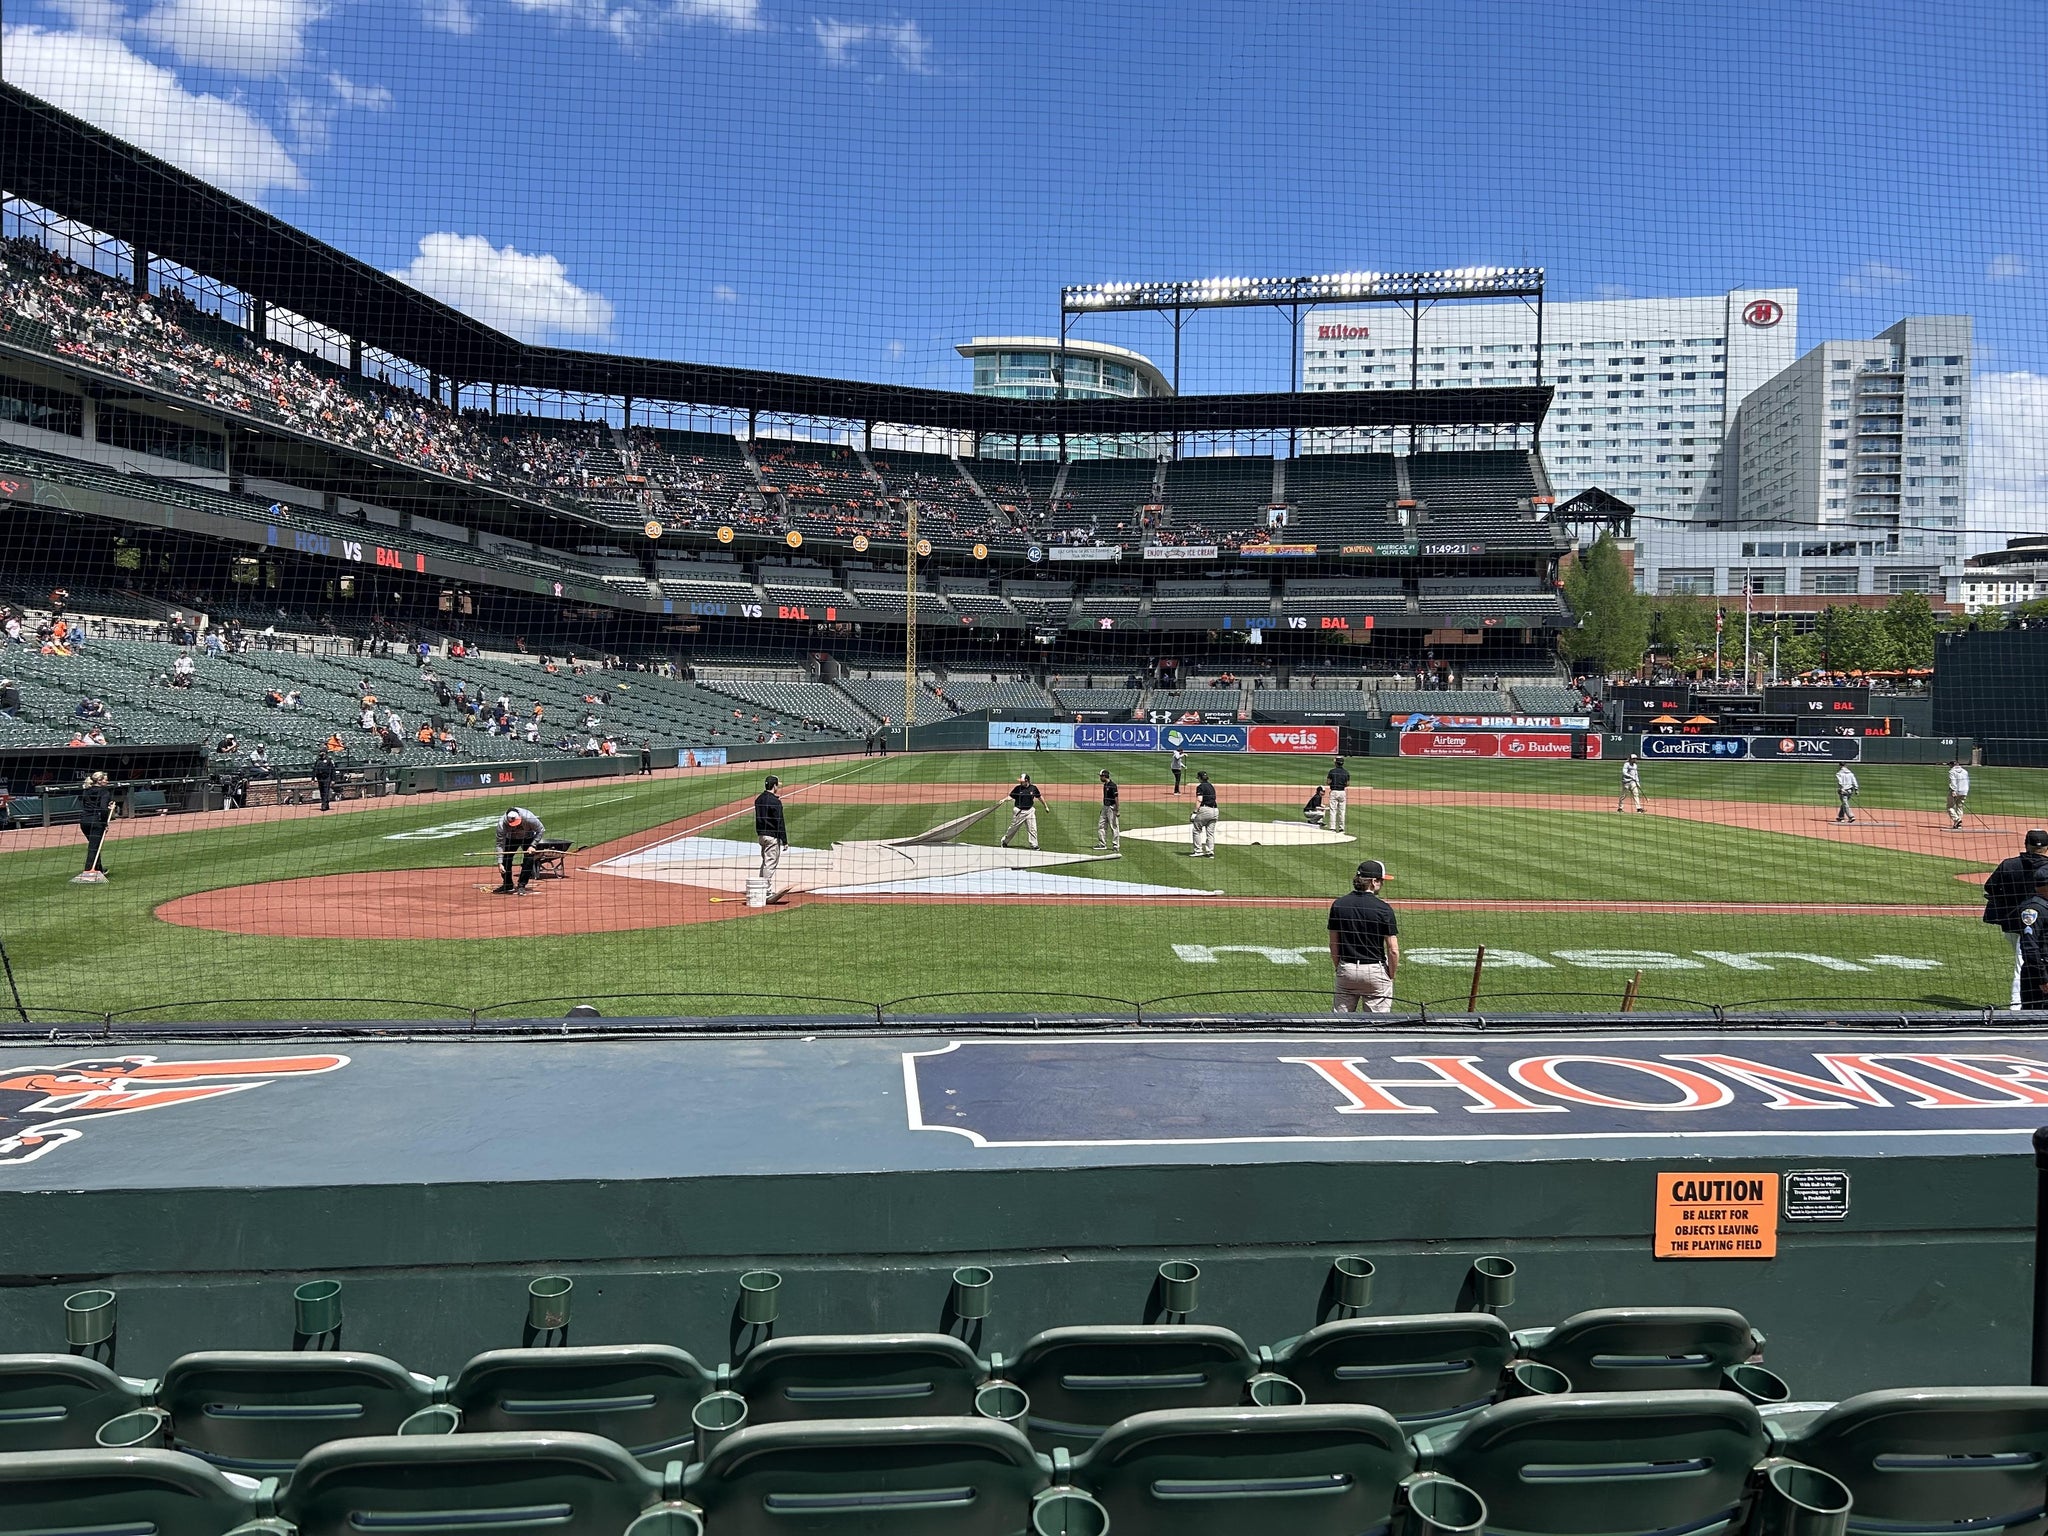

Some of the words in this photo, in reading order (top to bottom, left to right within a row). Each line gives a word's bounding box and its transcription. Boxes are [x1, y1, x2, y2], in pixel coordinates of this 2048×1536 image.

[1318, 323, 1369, 339] Hilton
[647, 525, 660, 536] 20
[854, 538, 866, 548] 22
[919, 543, 930, 553] 33
[295, 531, 331, 556] HOU
[343, 540, 362, 562] VS
[376, 547, 402, 569] BAL
[1029, 549, 1039, 559] 42
[1425, 544, 1466, 554] 11:49:21
[690, 602, 728, 616] HOU
[741, 604, 763, 618] VS
[778, 606, 810, 620] BAL
[1245, 617, 1277, 629] HOU
[1288, 617, 1307, 629] VS
[1321, 617, 1349, 629] BAL
[1809, 701, 1823, 710] VS
[1833, 701, 1855, 710] BAL
[1481, 717, 1513, 726] BIRD
[1516, 717, 1551, 727] BATH
[1082, 729, 1151, 742] LECOM
[1268, 729, 1318, 745] weis
[1865, 728, 1886, 736] BAL
[1184, 733, 1240, 744] VANDA
[1433, 735, 1467, 747] Airtemp
[1652, 740, 1710, 754] CareFirst
[1796, 740, 1831, 752] PNC
[480, 773, 492, 784] VS
[498, 772, 515, 783] BAL
[1672, 1180, 1763, 1202] CAUTION
[1683, 1210, 1695, 1220] BE
[1698, 1210, 1727, 1220] ALERT
[1730, 1210, 1749, 1219] FOR
[1675, 1225, 1715, 1236] OBJECTS
[1718, 1225, 1759, 1235] LEAVING
[1671, 1241, 1689, 1251] THE
[1692, 1240, 1733, 1250] PLAYING
[1736, 1240, 1762, 1250] FIELD
